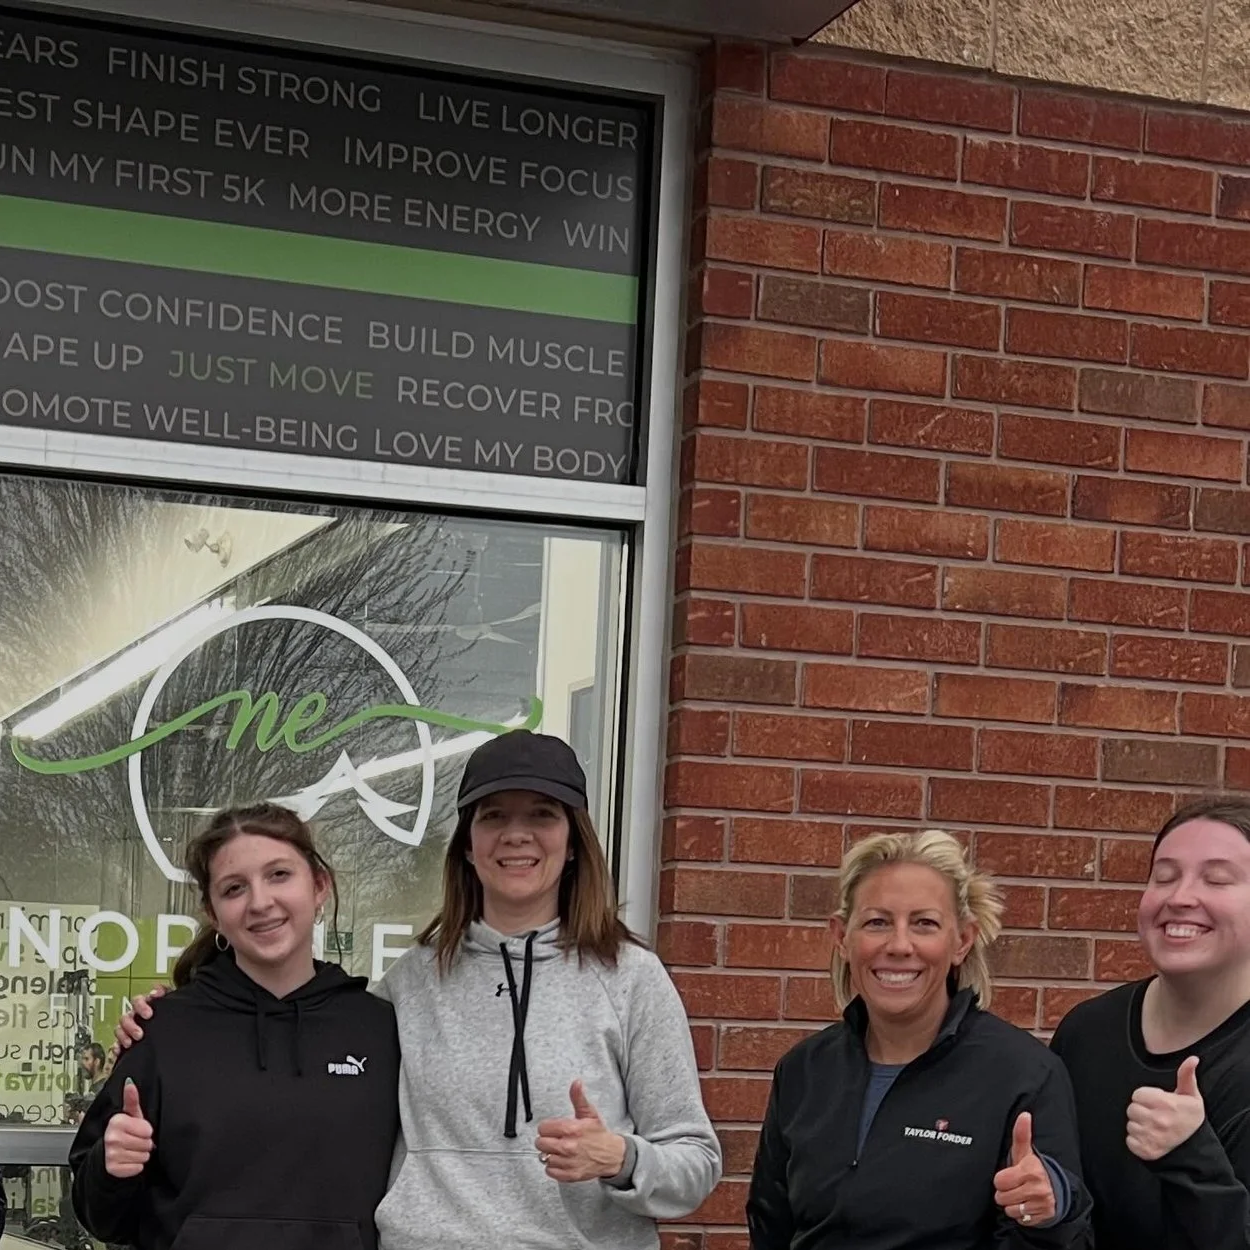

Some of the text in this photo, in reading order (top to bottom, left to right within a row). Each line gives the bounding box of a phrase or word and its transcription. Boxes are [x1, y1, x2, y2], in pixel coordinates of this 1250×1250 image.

[109, 48, 224, 90] FINISH
[238, 67, 380, 112] STRONG
[420, 93, 489, 128] LIVE
[502, 106, 637, 149] LONGER
[73, 100, 199, 142] SHAPE
[216, 119, 308, 158] EVER
[345, 138, 506, 184] IMPROVE
[521, 163, 633, 202] FOCUS
[51, 151, 103, 183] MY
[116, 160, 213, 198] FIRST
[223, 175, 264, 206] 5K
[290, 184, 391, 222] MORE
[405, 199, 540, 241] ENERGY
[563, 219, 629, 254] WIN
[100, 291, 342, 343] CONFIDENCE
[369, 322, 474, 358] BUILD
[489, 336, 624, 376] MUSCLE
[94, 342, 143, 371] UP
[169, 351, 257, 384] JUST
[270, 362, 373, 398] MOVE
[398, 377, 560, 419] RECOVER
[143, 404, 358, 454] WELL-BEING
[374, 427, 462, 466] LOVE
[475, 439, 524, 472] MY
[534, 446, 626, 480] BODY
[904, 1127, 972, 1145] TAYLOR FORDER
